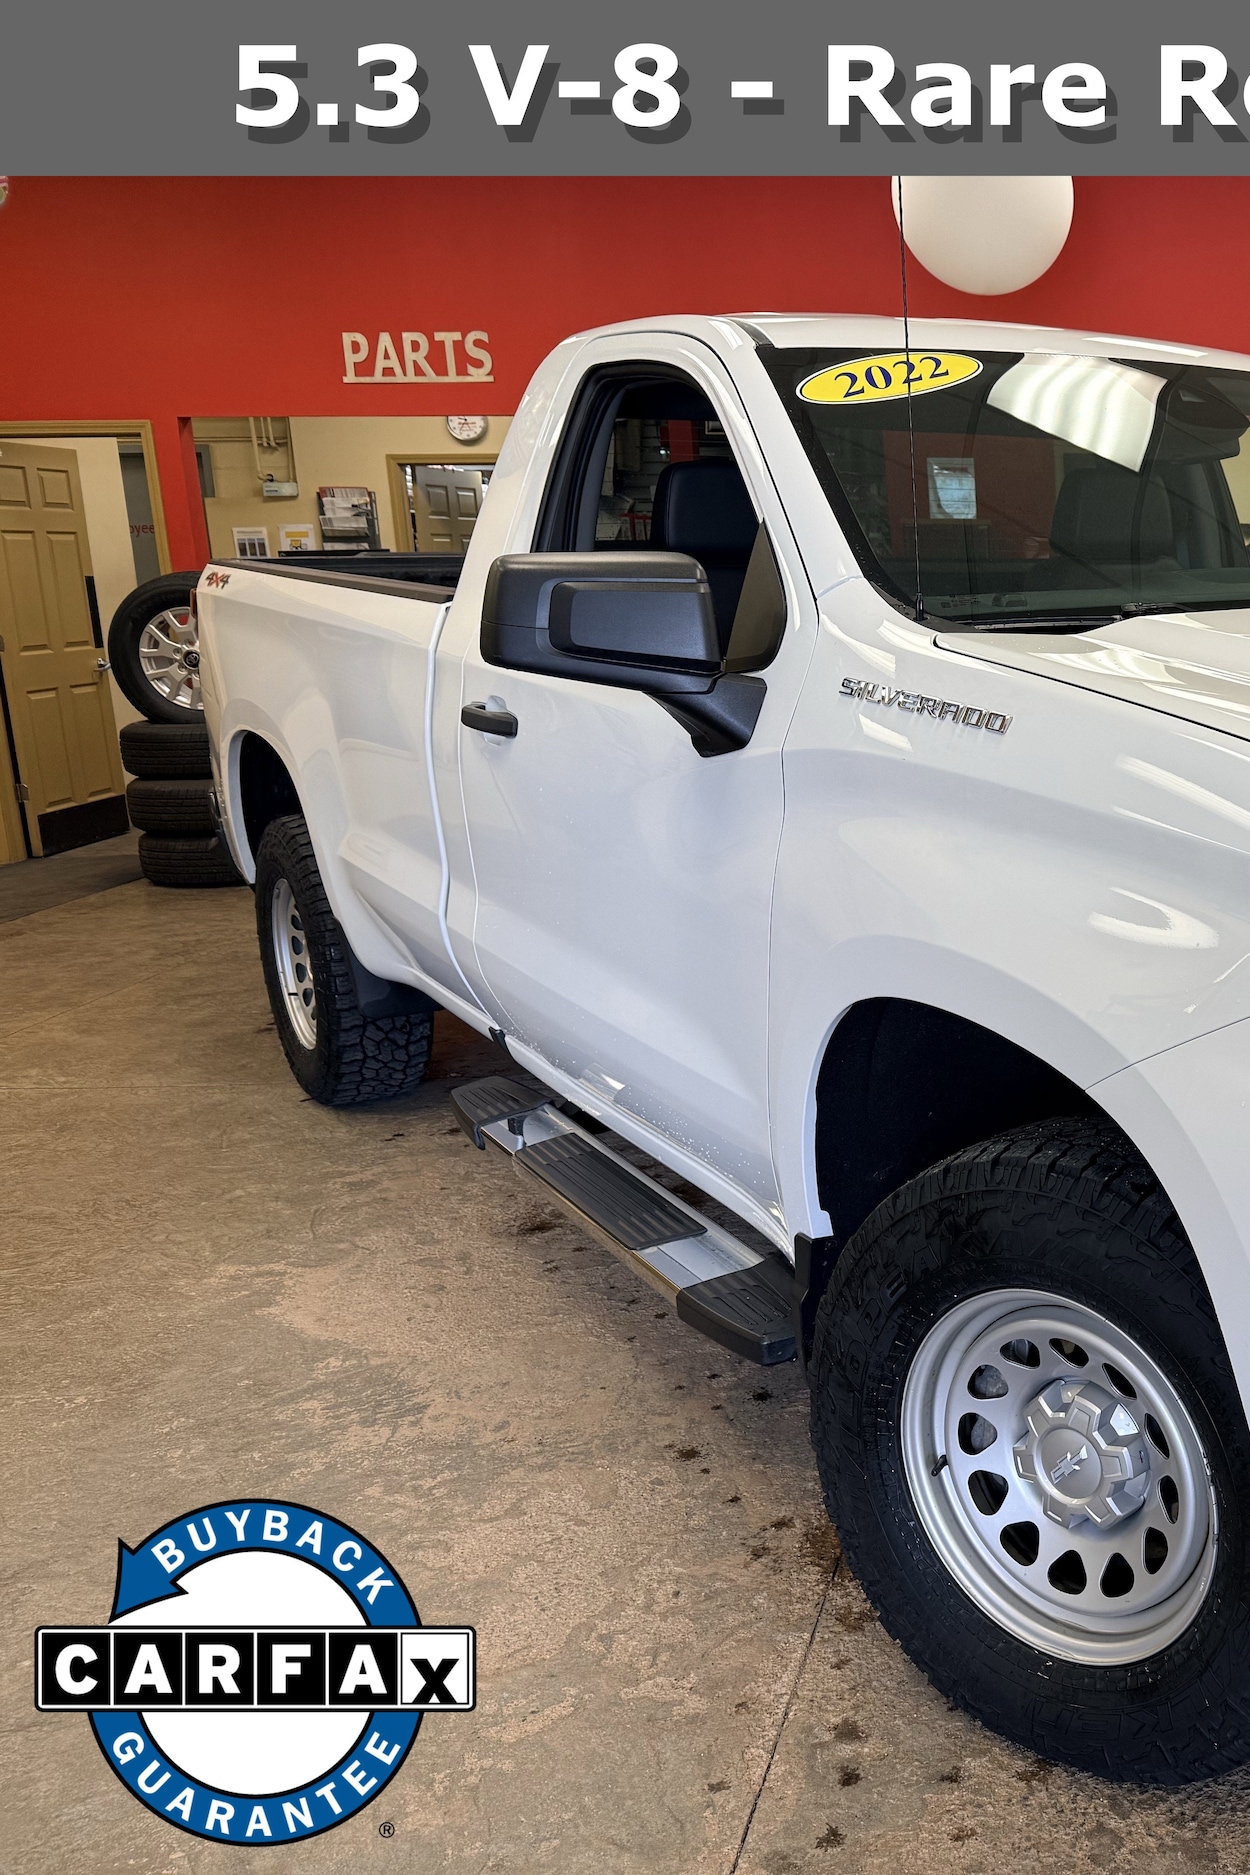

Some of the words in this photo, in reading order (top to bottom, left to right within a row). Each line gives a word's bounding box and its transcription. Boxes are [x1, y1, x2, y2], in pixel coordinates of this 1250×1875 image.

[342, 330, 493, 378] PARTS
[834, 356, 949, 399] 2022
[840, 677, 1013, 735] SILVERADO
